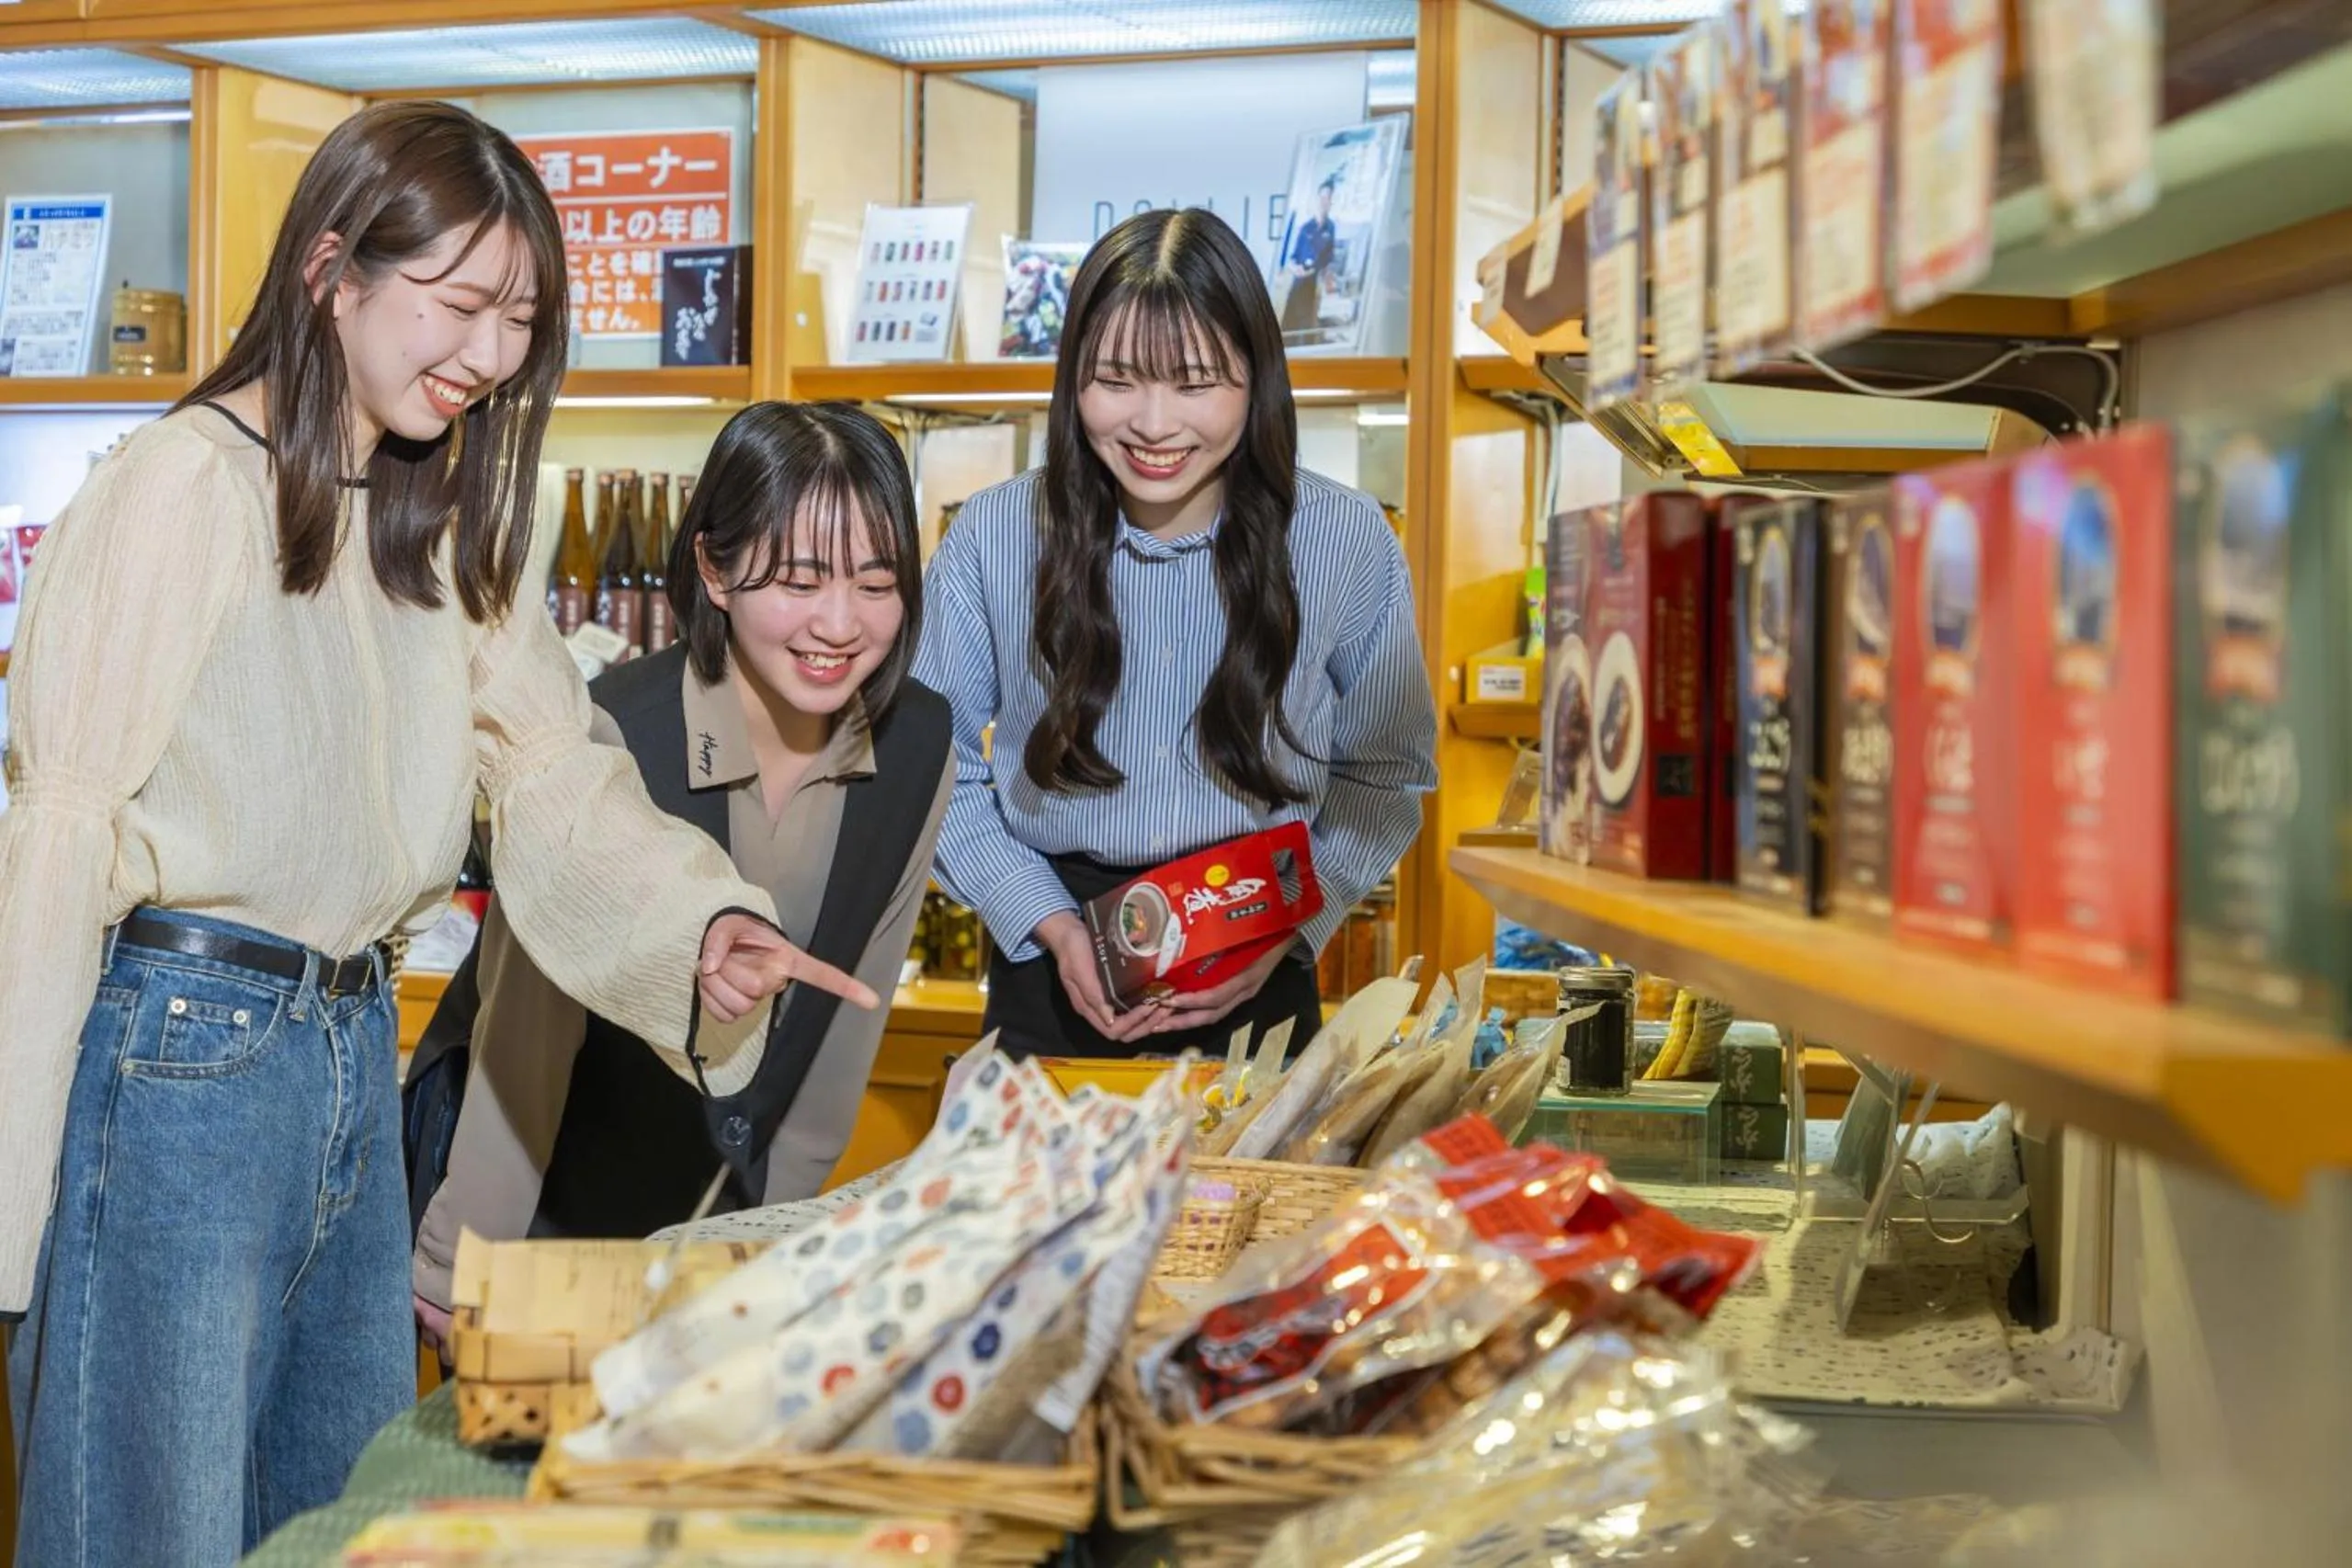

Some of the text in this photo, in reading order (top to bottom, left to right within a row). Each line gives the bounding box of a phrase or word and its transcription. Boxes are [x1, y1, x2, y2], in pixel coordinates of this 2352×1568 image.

[565, 204, 722, 244] 以上の年齢
[699, 733, 719, 778] Happy
